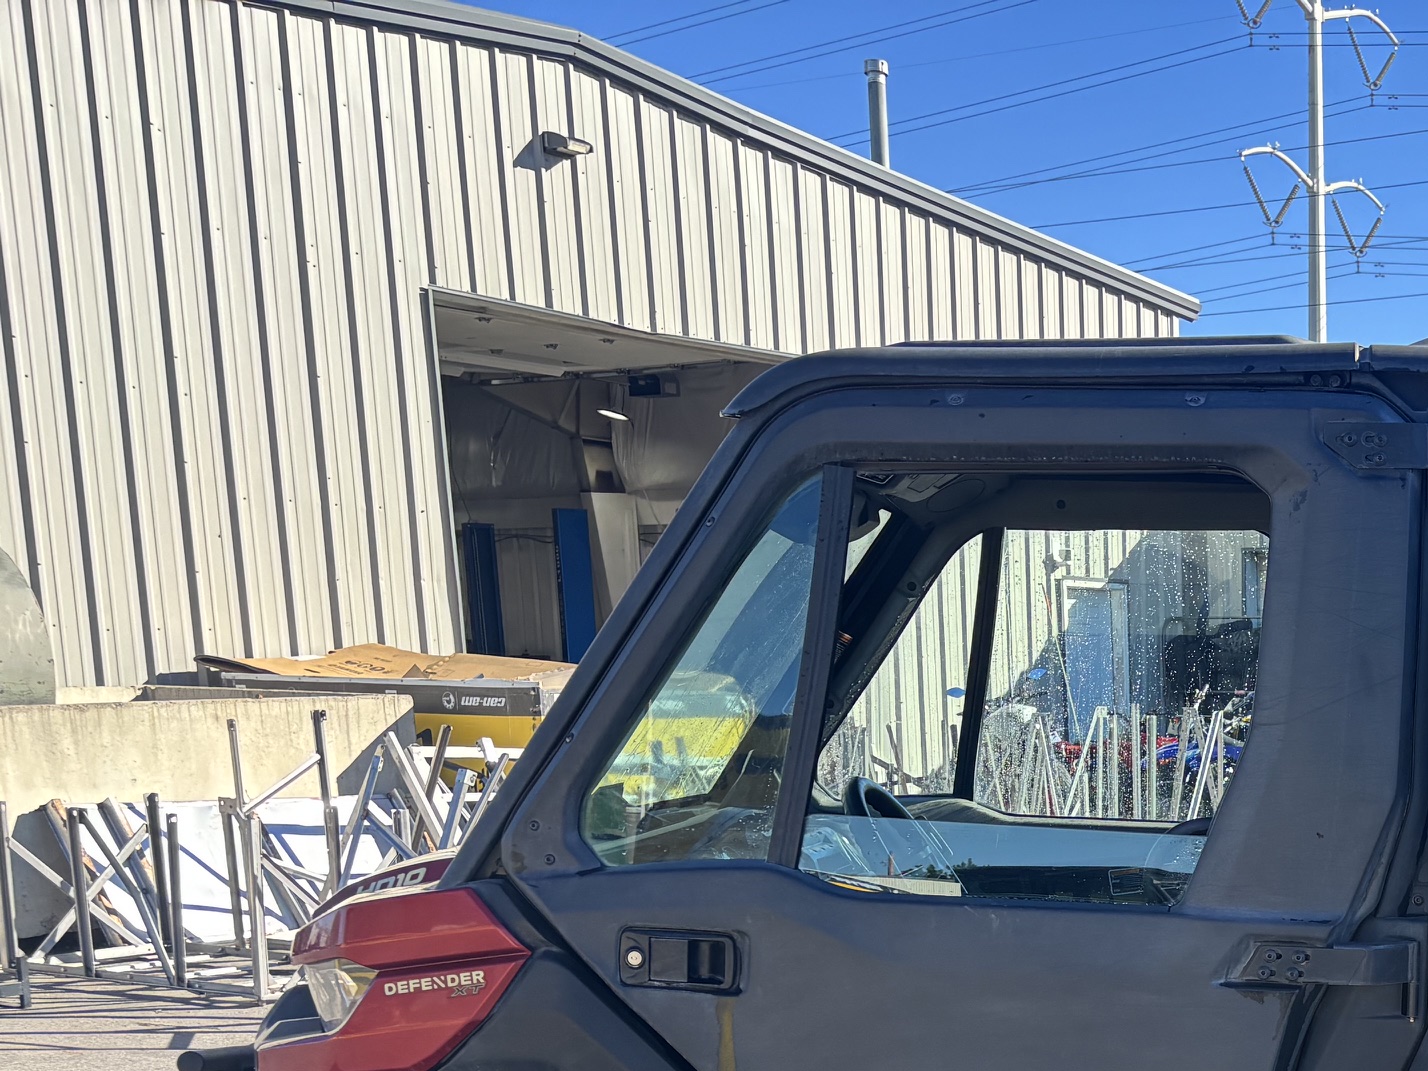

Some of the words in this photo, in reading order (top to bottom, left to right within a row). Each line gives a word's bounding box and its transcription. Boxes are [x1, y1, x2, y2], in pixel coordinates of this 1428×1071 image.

[460, 696, 506, 707] can-am
[384, 970, 485, 996] DEFENDER
[451, 983, 486, 997] XT
